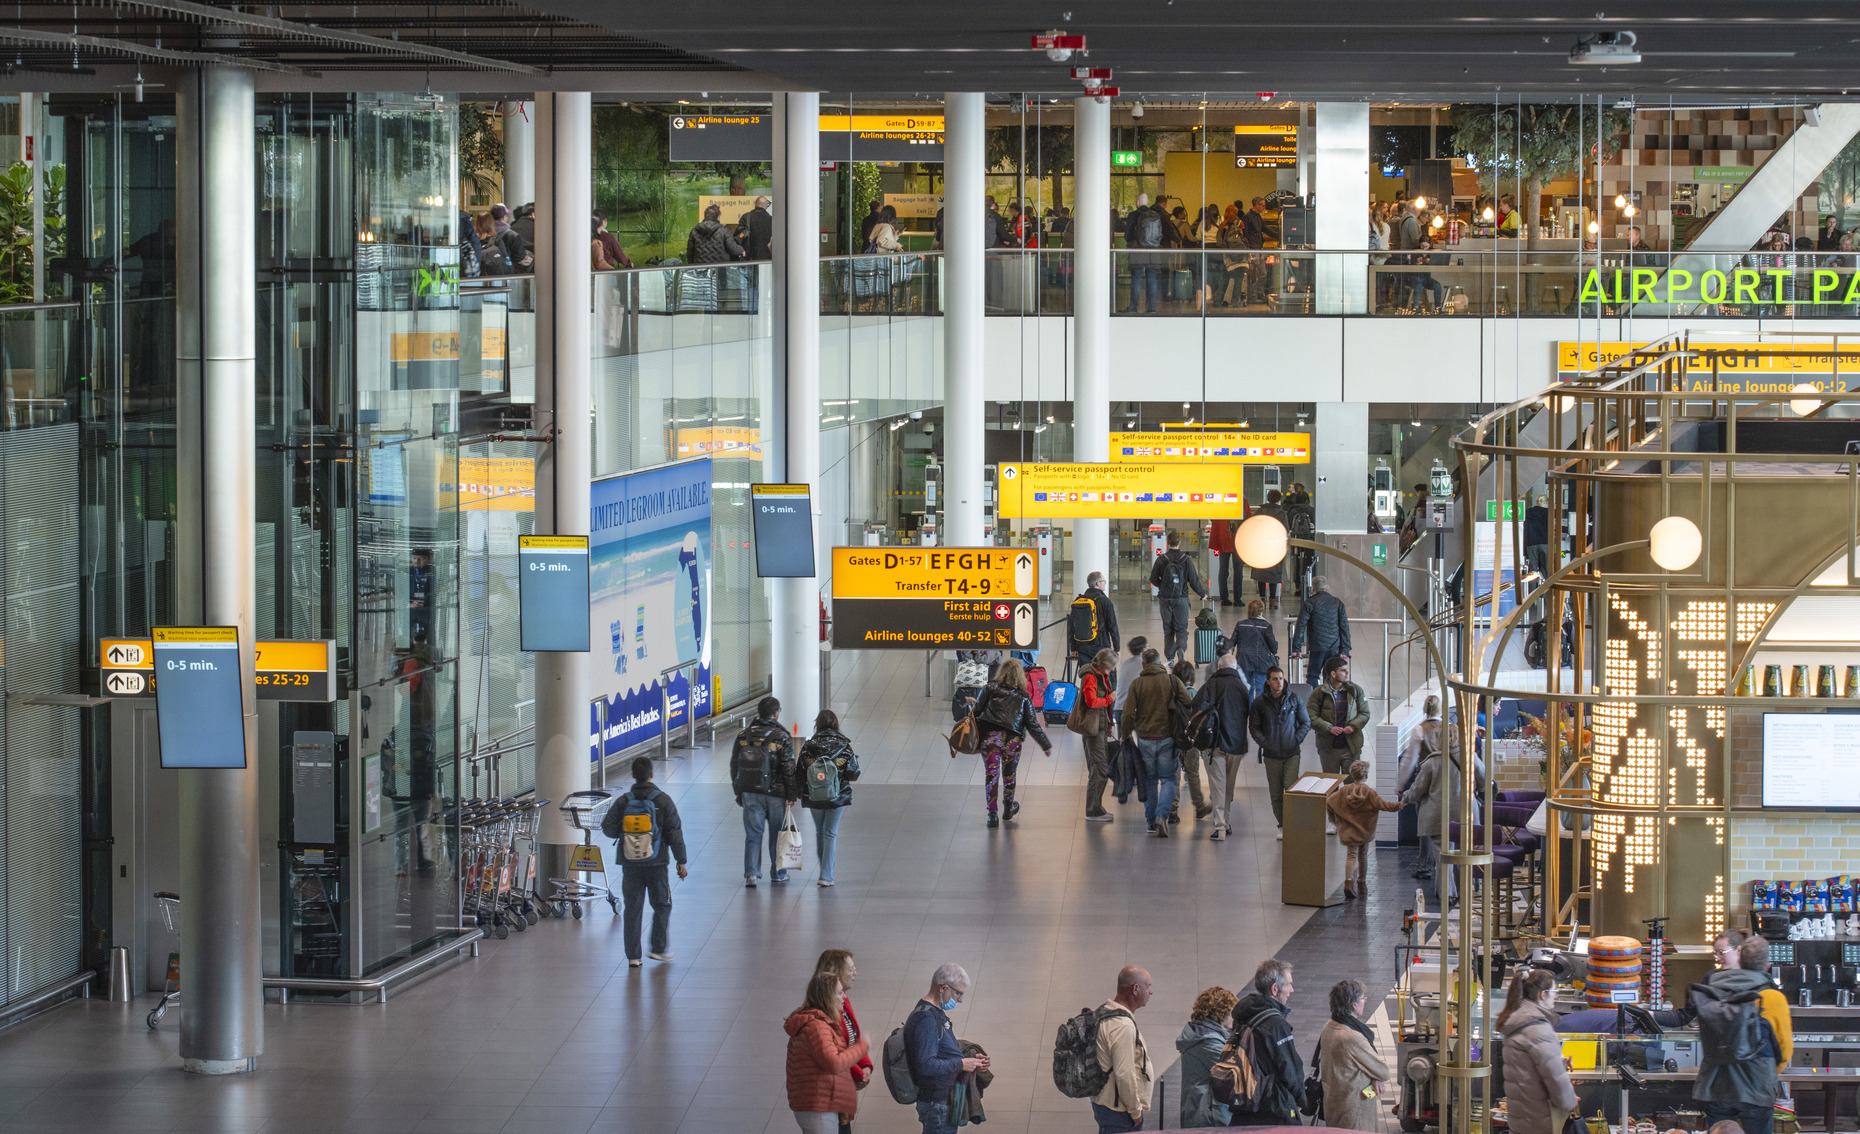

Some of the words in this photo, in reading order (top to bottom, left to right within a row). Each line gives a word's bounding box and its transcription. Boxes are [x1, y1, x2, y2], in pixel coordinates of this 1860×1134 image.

[724, 116, 750, 125] lounge
[885, 132, 914, 140] lounges
[1580, 268, 1792, 304] AIRPORT
[1692, 380, 1740, 392] Airine
[1746, 380, 1798, 392] lounge
[1084, 466, 1122, 474] passport
[591, 500, 625, 532] LIMITED
[626, 490, 665, 524] LEGROOM
[530, 562, 546, 571] 0-5
[548, 562, 571, 571] min.
[849, 556, 881, 566] Gates
[895, 581, 942, 591] Transfer
[944, 578, 991, 595] T4-9
[944, 601, 970, 612] First
[972, 601, 991, 611] aid
[974, 613, 991, 622] hulp
[864, 630, 904, 641] Airline
[908, 630, 954, 643] lounges
[957, 631, 991, 641] 40-52
[167, 660, 187, 670] 0-5
[190, 660, 218, 670] min.
[272, 674, 309, 685] 25-29
[609, 716, 630, 739] America's
[630, 713, 641, 730] Best
